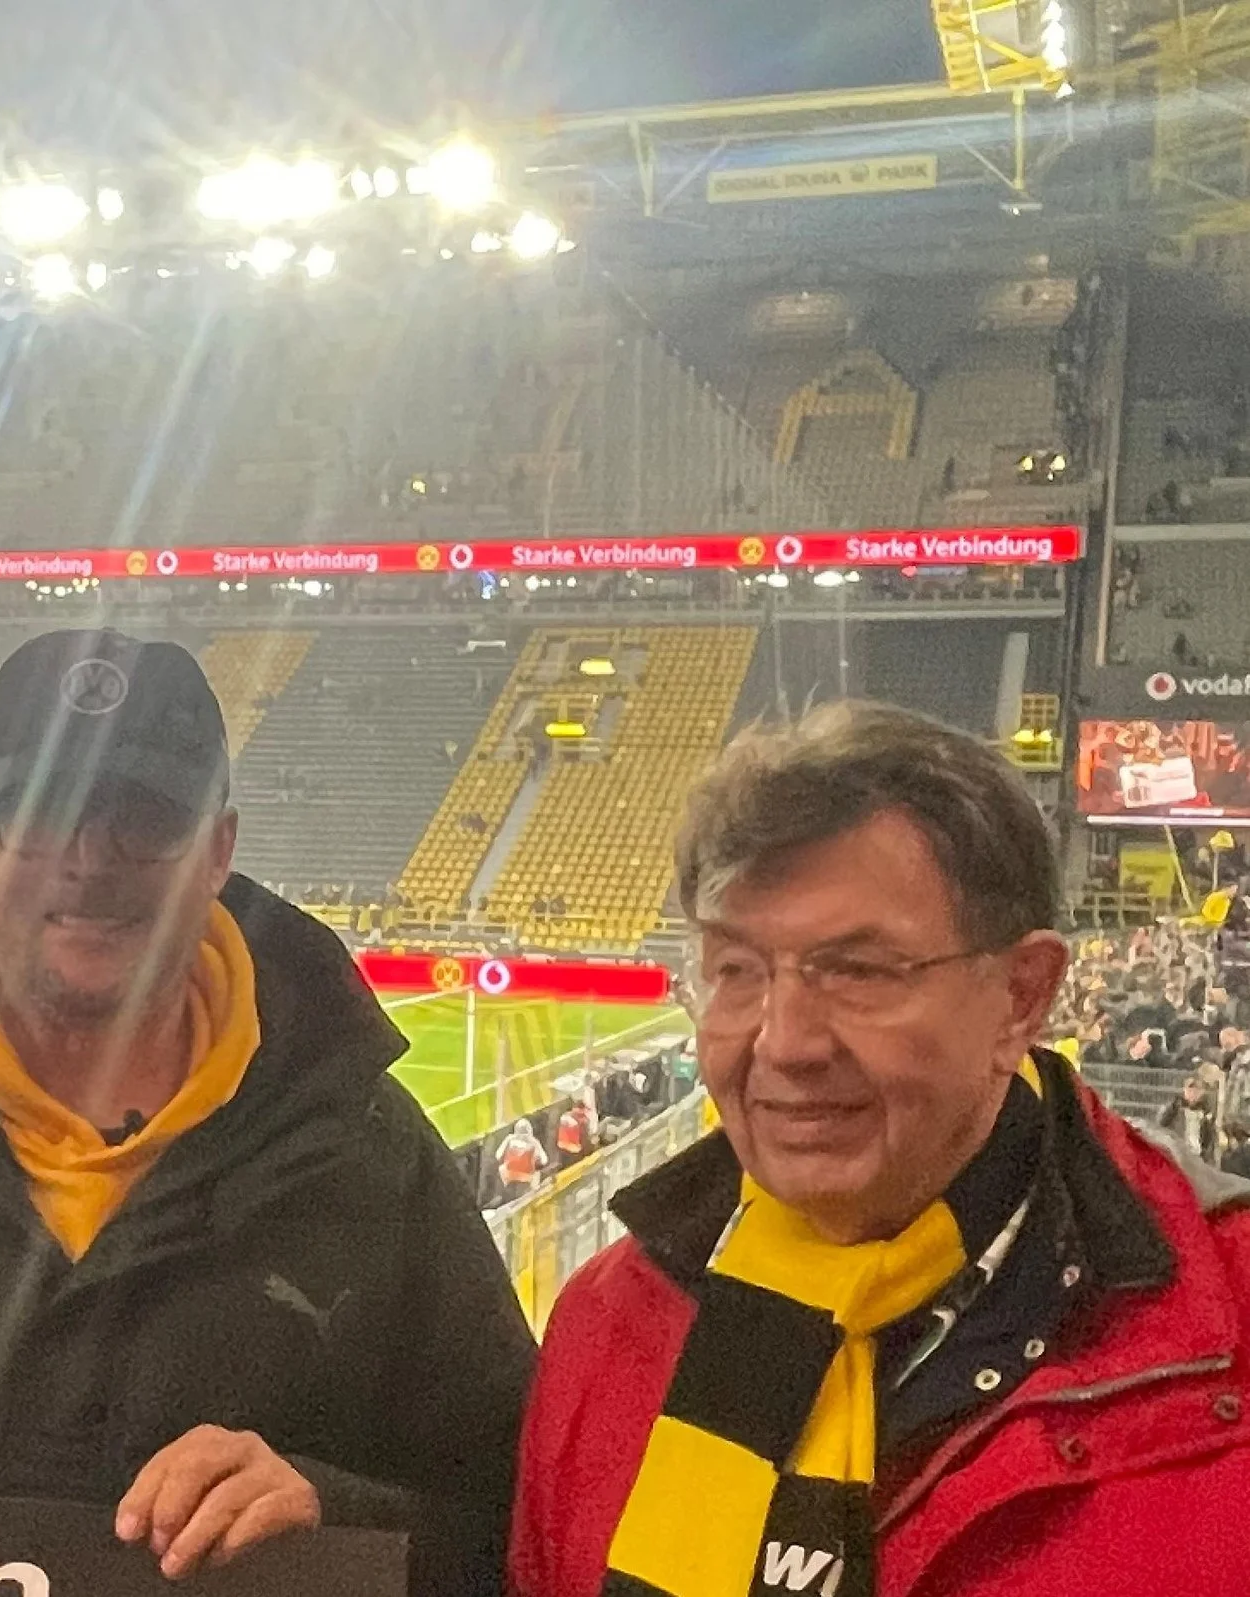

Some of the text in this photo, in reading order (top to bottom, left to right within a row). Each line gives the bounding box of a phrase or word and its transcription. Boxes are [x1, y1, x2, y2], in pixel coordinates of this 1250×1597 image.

[877, 163, 928, 180] PARK
[512, 542, 697, 567] Starke Verbindung
[846, 535, 1052, 561] Starke Verbindung
[213, 550, 378, 573] Starke Verbindung
